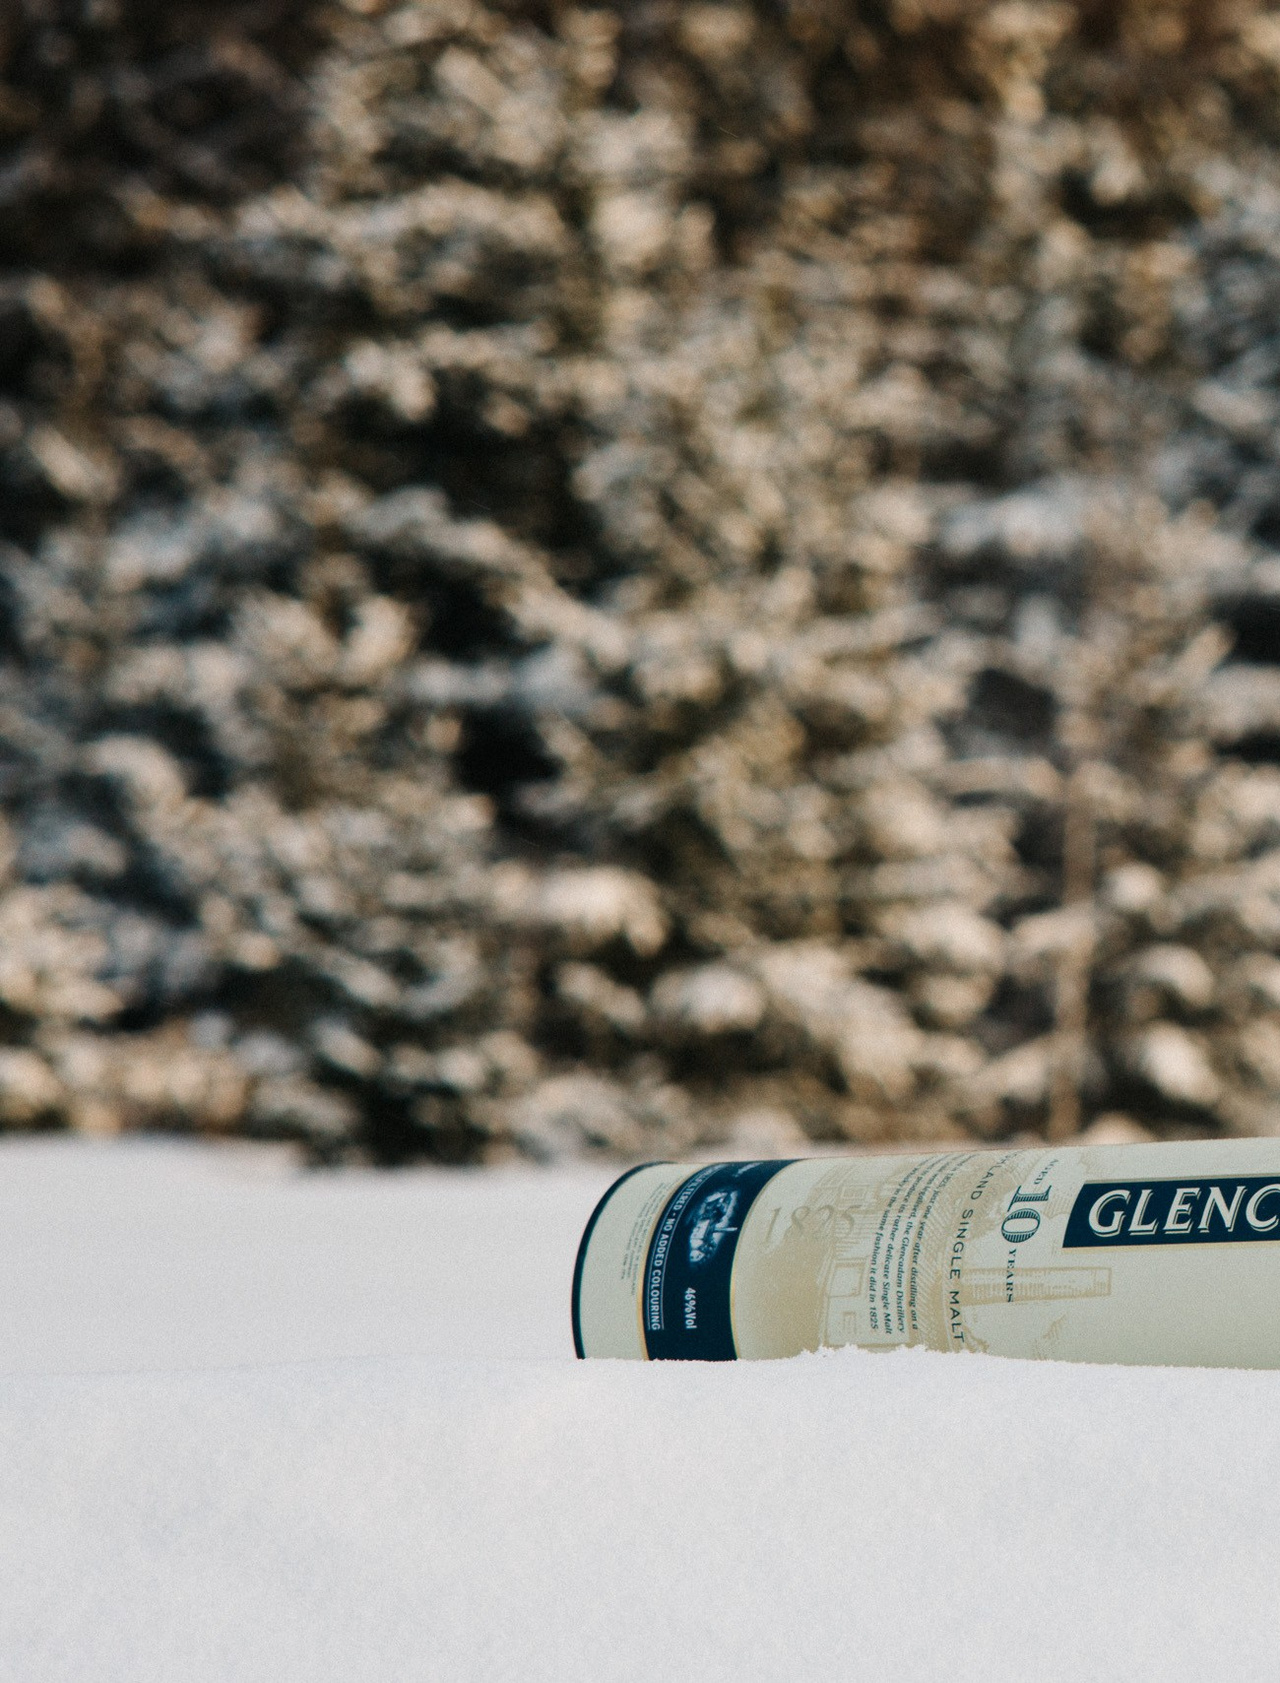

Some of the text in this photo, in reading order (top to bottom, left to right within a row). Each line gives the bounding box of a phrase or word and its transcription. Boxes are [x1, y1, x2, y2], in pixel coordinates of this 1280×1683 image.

[887, 1196, 897, 1208] the
[923, 1205, 932, 1219] one
[1001, 1185, 1052, 1243] 10
[662, 1218, 676, 1232] NO
[879, 1209, 890, 1231] same
[889, 1215, 901, 1241] rather
[904, 1221, 913, 1235] the
[917, 1221, 926, 1241] year
[654, 1234, 673, 1266] ADDED
[871, 1232, 884, 1265] fashion
[913, 1242, 921, 1265] after
[949, 1208, 974, 1279] SINGLE
[882, 1243, 894, 1279] delicate
[896, 1237, 910, 1288] Glencadam
[869, 1276, 877, 1291] did
[908, 1267, 919, 1307] distilling
[1005, 1248, 1017, 1303] YEARS
[650, 1269, 663, 1331] COLOURING
[685, 1287, 697, 1329] 46%Vol
[869, 1293, 876, 1302] in
[881, 1282, 890, 1310] Single
[869, 1307, 878, 1330] 1825
[884, 1312, 893, 1335] Malt
[896, 1291, 905, 1333] Distillery
[911, 1309, 918, 1322] on
[949, 1291, 965, 1343] MALT
